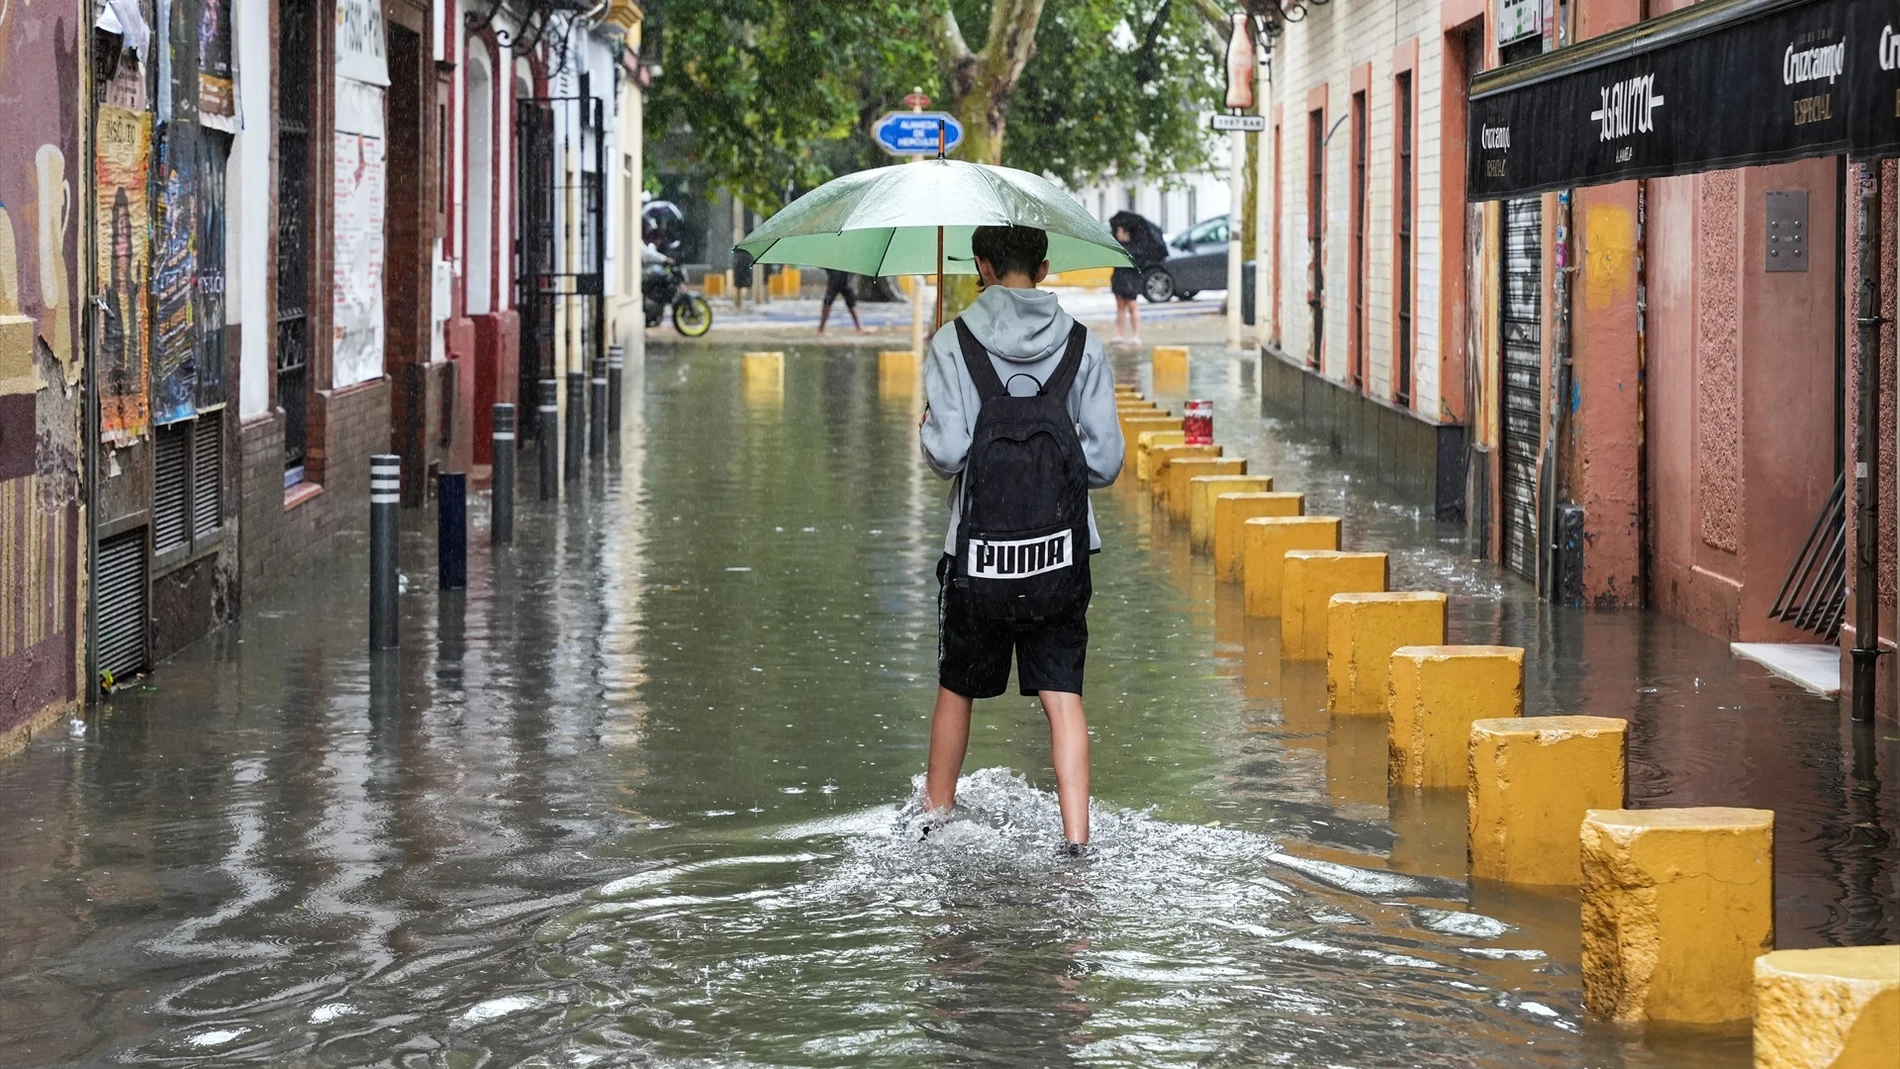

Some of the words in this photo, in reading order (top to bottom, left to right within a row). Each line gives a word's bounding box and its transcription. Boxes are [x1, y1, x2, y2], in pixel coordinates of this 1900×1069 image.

[1783, 36, 1846, 85] Cruzcampo
[900, 120, 939, 129] ALAMEDA
[1794, 94, 1832, 125] ESPECIAL
[912, 129, 926, 138] DE
[976, 535, 1065, 575] PUMA
